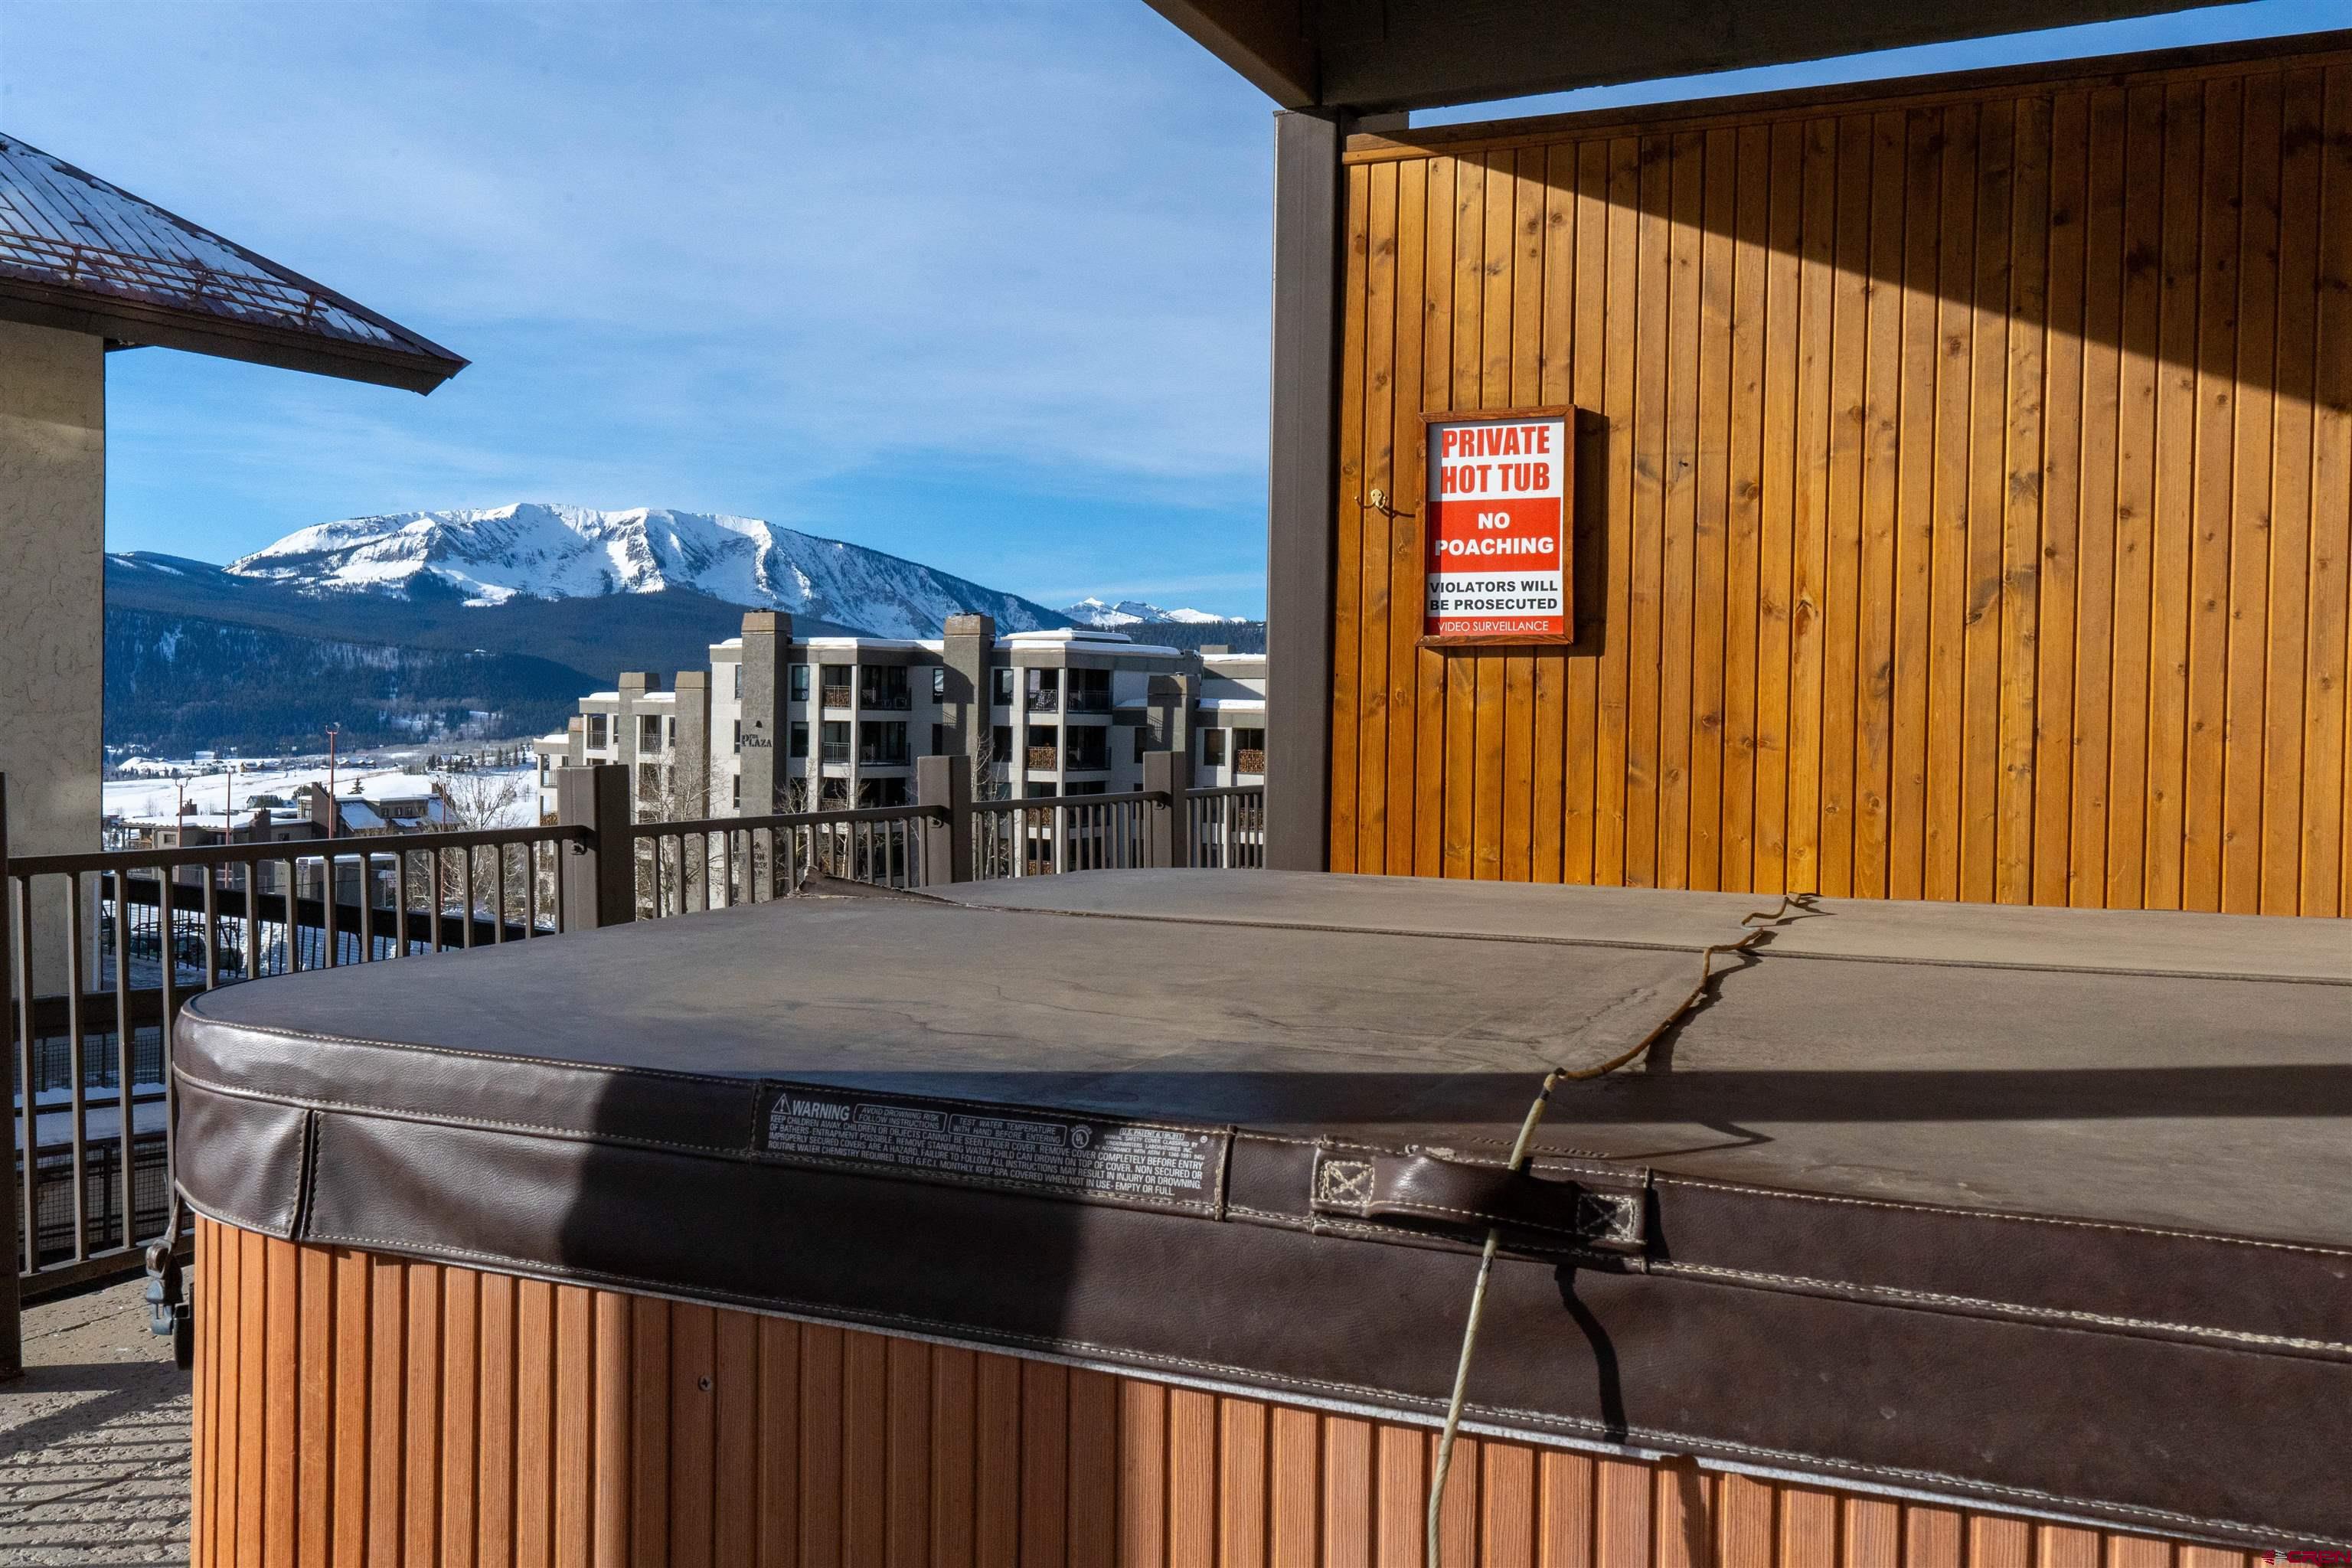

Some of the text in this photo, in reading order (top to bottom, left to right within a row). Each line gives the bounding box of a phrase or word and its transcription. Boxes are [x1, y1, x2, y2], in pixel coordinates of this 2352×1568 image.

[1442, 426, 1550, 458] PRIVATE
[1441, 462, 1550, 494] HOT TUB
[1478, 512, 1510, 529] NO
[1435, 537, 1554, 556] POACHING
[1430, 580, 1558, 593] VIOLATORS WILL
[1430, 598, 1557, 610] BE PROSECUTED
[1438, 620, 1548, 632] VIDEO SURVEILLANCE
[741, 734, 773, 747] PLAZA
[792, 1099, 850, 1122] WARNING
[884, 1109, 921, 1119] DROWNING
[859, 1114, 939, 1129] FOLLOW INSTRUCTIONS
[959, 1118, 1056, 1135] TEST WATER TEMPERATURE
[770, 1115, 786, 1123] KEEP
[787, 1116, 818, 1127] CHILDREN
[843, 1122, 876, 1133] CHILDREN
[890, 1128, 920, 1138] OBJECTS
[923, 1132, 951, 1142] CANNOT
[965, 1136, 983, 1146] SEEN
[985, 1139, 1009, 1149] UNDER
[1040, 1145, 1070, 1156] REMOVE
[1072, 1148, 1096, 1159] COVER
[1098, 1151, 1146, 1165] COMPLETELY
[1148, 1156, 1177, 1168] BEFORE
[1178, 1159, 1203, 1170] ENTRY
[953, 1125, 1060, 1144] WITH HAND BEFORE ENTERING
[769, 1131, 1202, 1189] IMPROPERLY SECURED COVERS ARE A HAZARD. FAILURE TO FOLLOW ALL INSTRUCTIONS MAY RESULT IN INJURY OR DROWNING.
[769, 1140, 795, 1151] ROUTINE
[797, 1143, 820, 1154] WATER
[822, 1145, 859, 1158] CHEMISTRY
[899, 1155, 914, 1165] TEST
[976, 1165, 992, 1174] KEEP
[995, 1167, 1008, 1177] SPA
[1011, 1169, 1042, 1181] COVERED
[1044, 1173, 1067, 1184] WHEN
[1069, 1176, 1083, 1186] NOT
[1086, 1178, 1093, 1187] IN
[1116, 1181, 1140, 1192] EMPTY
[1142, 1184, 1153, 1194] OR
[1155, 1185, 1175, 1196] FULL.
[897, 1137, 925, 1148] REMOVE
[927, 1141, 964, 1152] STANDING
[1017, 1152, 1032, 1161] CAN
[1034, 1154, 1063, 1165] DROWN
[1065, 1158, 1076, 1166] ON
[1078, 1159, 1091, 1168] TOP
[1106, 1161, 1132, 1172] COVER.
[1135, 1165, 1152, 1174] NON
[1155, 1166, 1190, 1178] SECURED
[1192, 1170, 1202, 1180] OR
